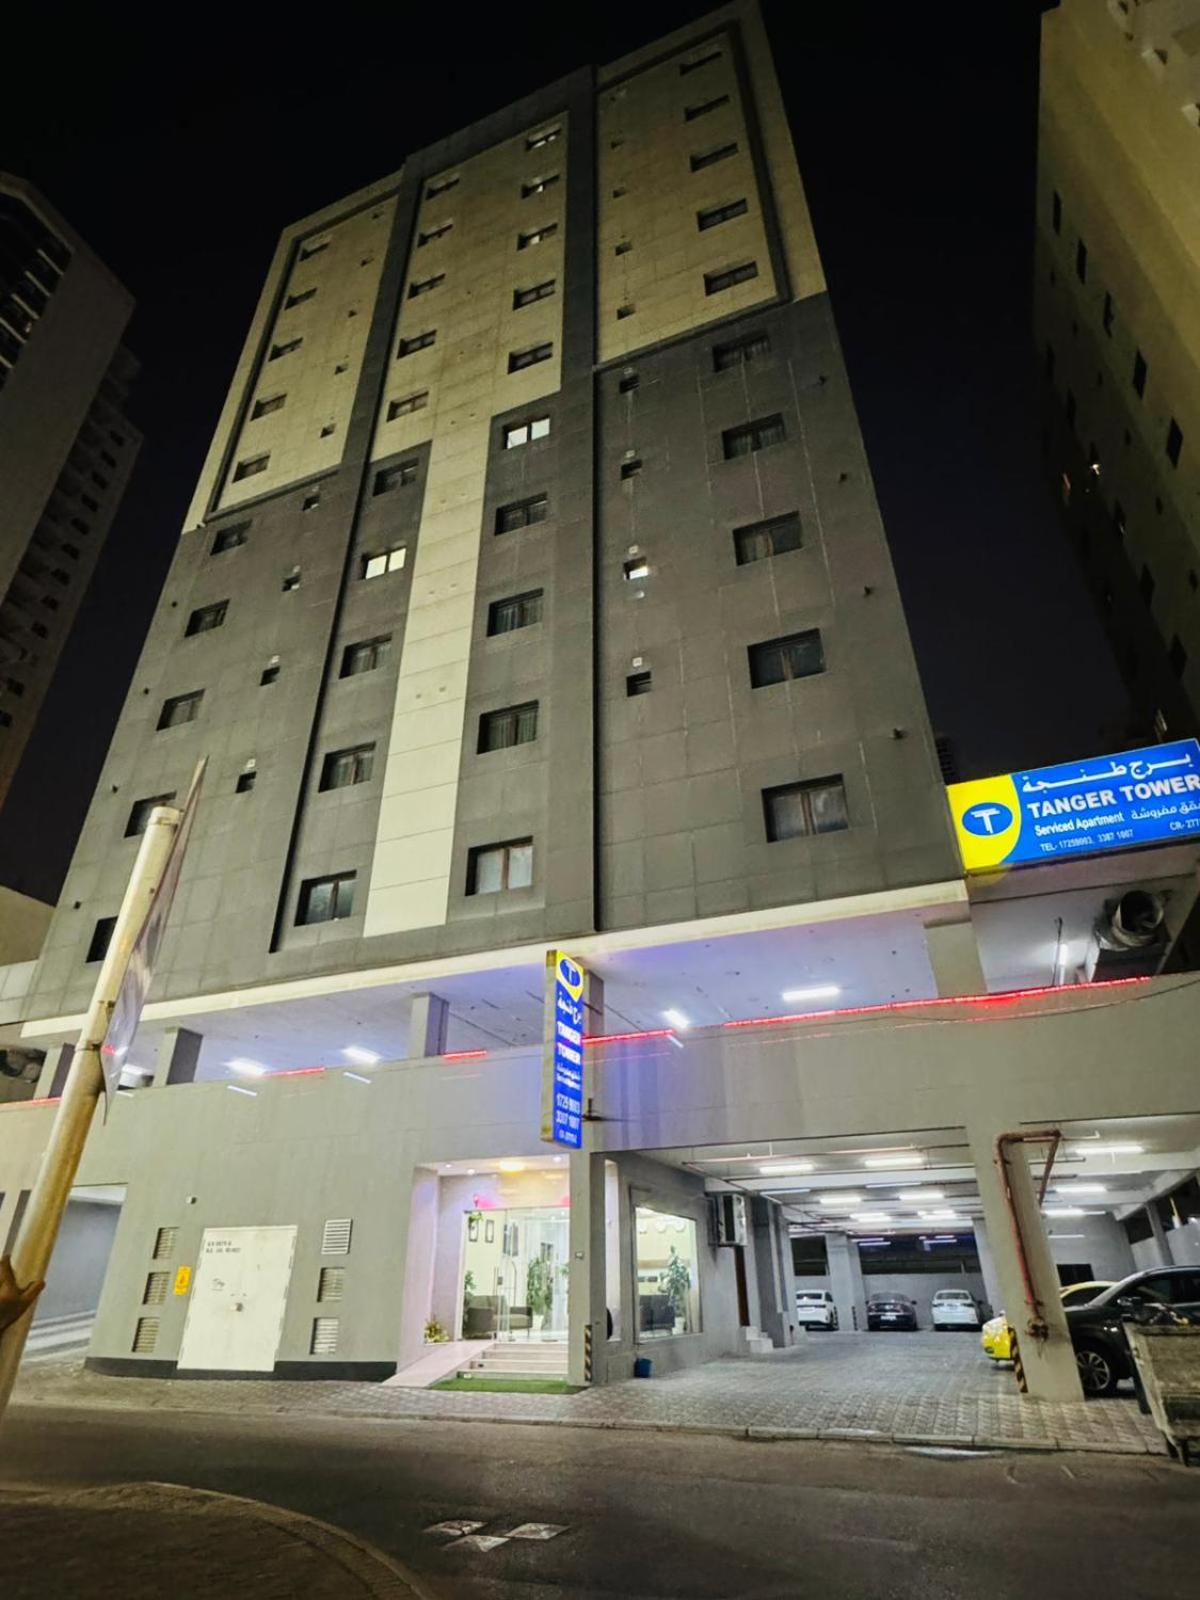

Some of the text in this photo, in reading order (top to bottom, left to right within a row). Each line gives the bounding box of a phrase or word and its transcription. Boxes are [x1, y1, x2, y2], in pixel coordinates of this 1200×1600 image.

[1022, 753, 1195, 795] برج طنجة
[1027, 773, 1200, 819] TANGER TOWER
[970, 808, 1000, 834] T
[1034, 811, 1125, 837] Serviced Apartment
[1130, 805, 1178, 820] مفروشة
